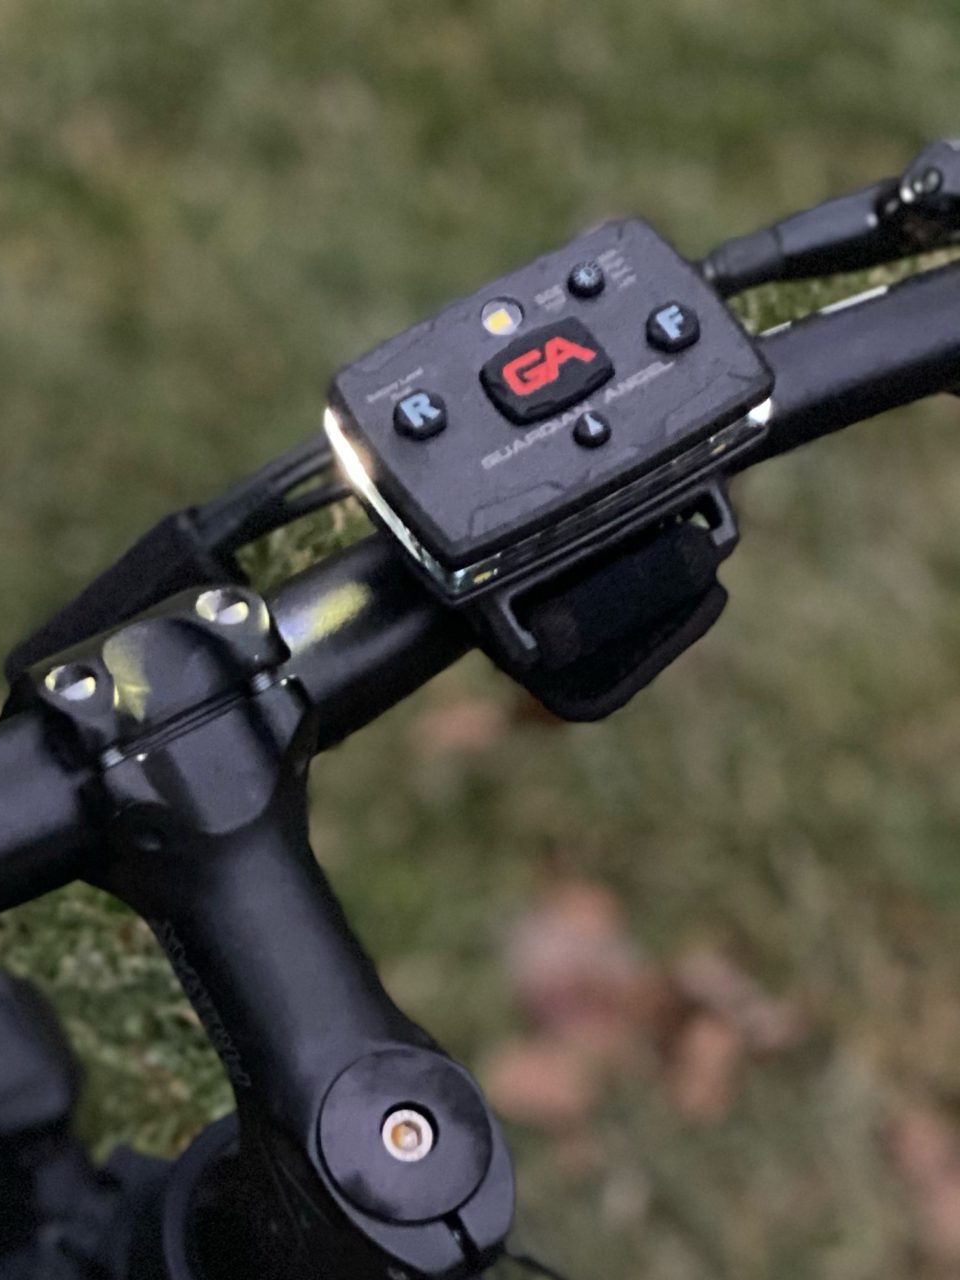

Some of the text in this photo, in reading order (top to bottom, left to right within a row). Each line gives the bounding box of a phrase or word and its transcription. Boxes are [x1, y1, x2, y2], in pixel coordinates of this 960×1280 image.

[655, 305, 686, 340] F
[502, 336, 597, 397] GA
[400, 393, 441, 429] R
[482, 360, 675, 471] GUARDIAN ANGEL
